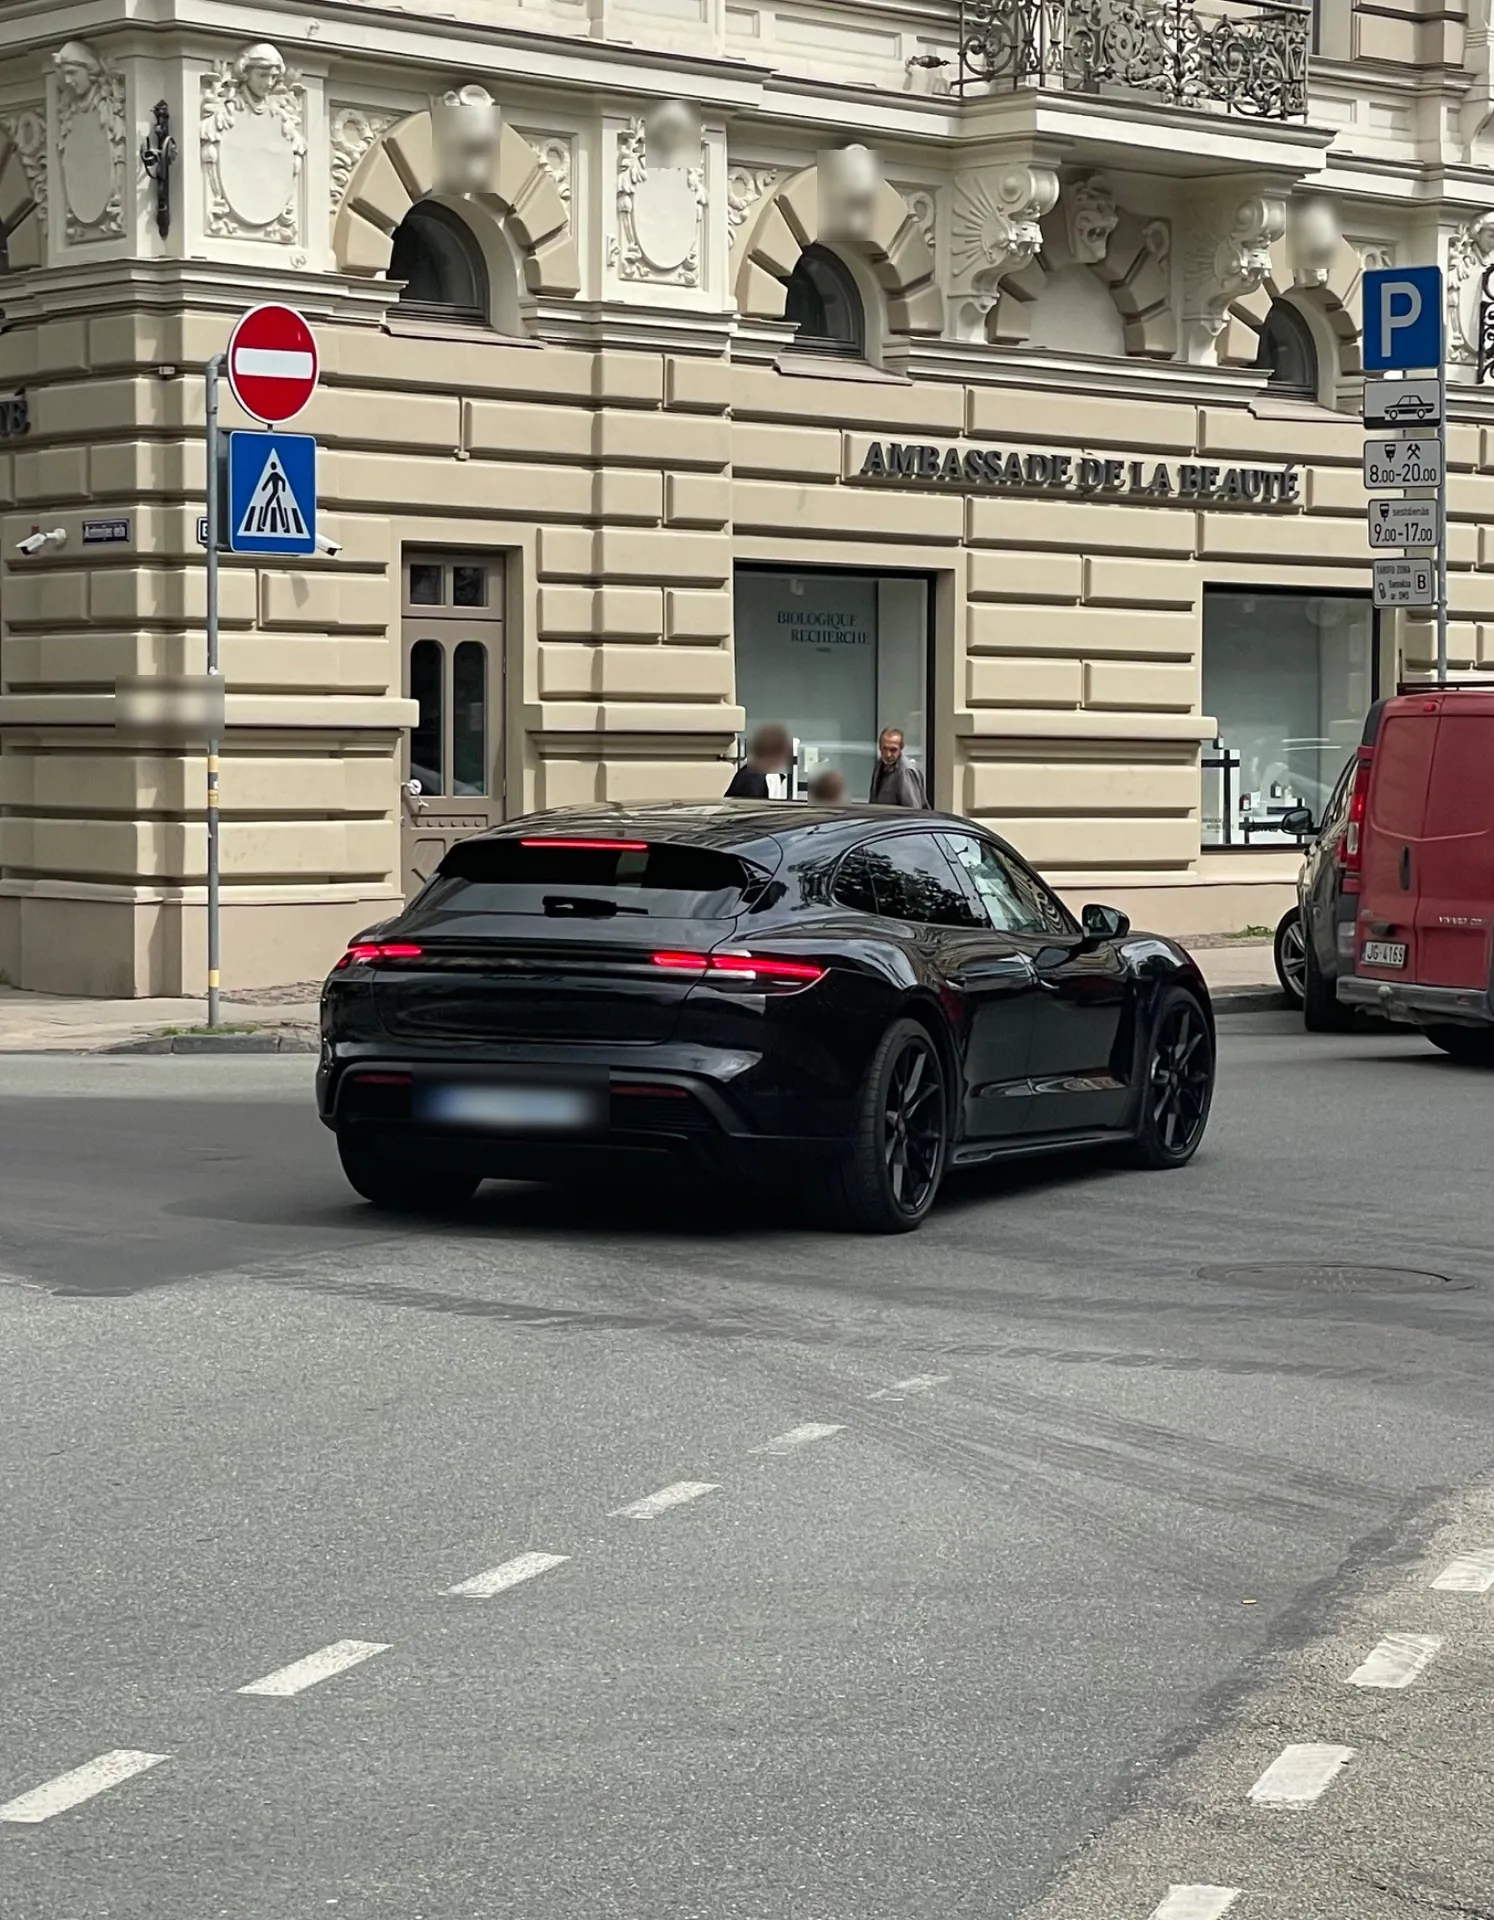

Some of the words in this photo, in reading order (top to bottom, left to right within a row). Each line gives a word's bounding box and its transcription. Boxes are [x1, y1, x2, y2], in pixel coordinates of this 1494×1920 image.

[1380, 281, 1422, 358] P
[860, 441, 1073, 484] AMBASSADE
[1079, 456, 1126, 489] DE
[1130, 461, 1174, 493] LA
[1178, 460, 1301, 502] BEAUTÉ
[1417, 574, 1427, 590] B
[777, 610, 859, 629] BIOLOGIQUE
[791, 628, 871, 645] RECHERCHE
